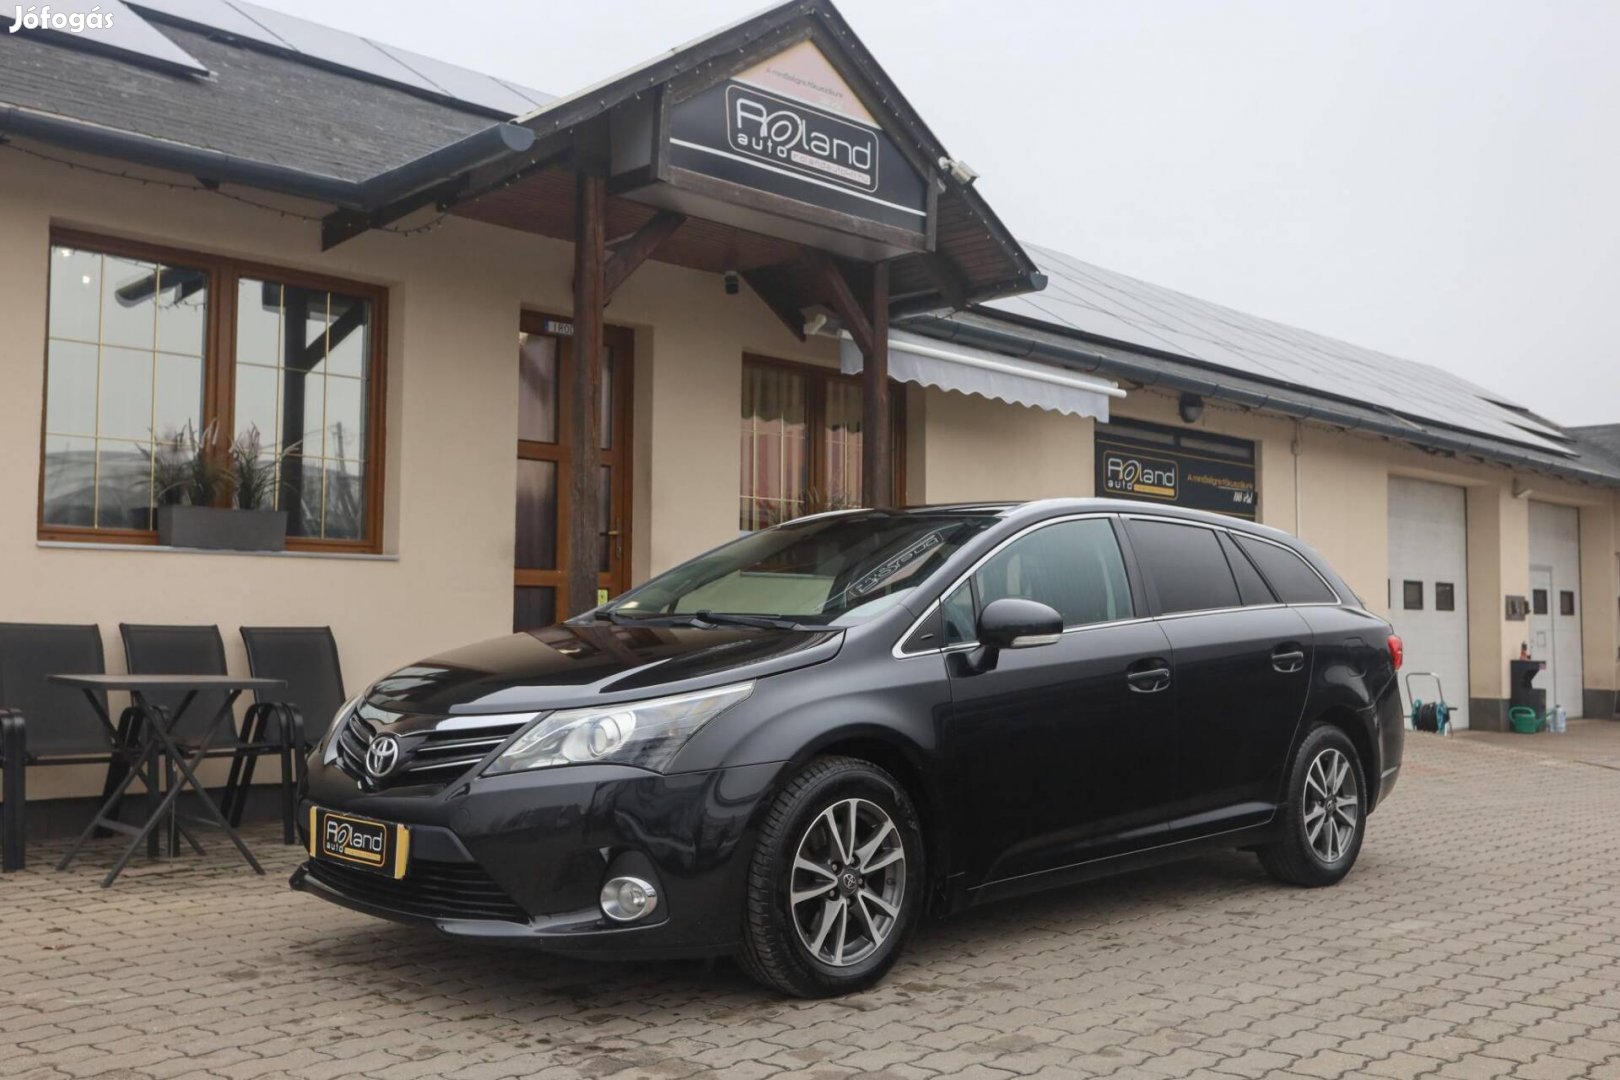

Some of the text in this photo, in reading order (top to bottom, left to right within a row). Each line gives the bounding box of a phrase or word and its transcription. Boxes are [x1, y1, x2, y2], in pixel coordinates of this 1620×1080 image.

[737, 98, 870, 169] Roland
[737, 133, 788, 158] auto
[1108, 458, 1175, 487] Roland
[1108, 480, 1133, 490] auto
[326, 842, 344, 853] auto
[327, 820, 383, 851] Roland
